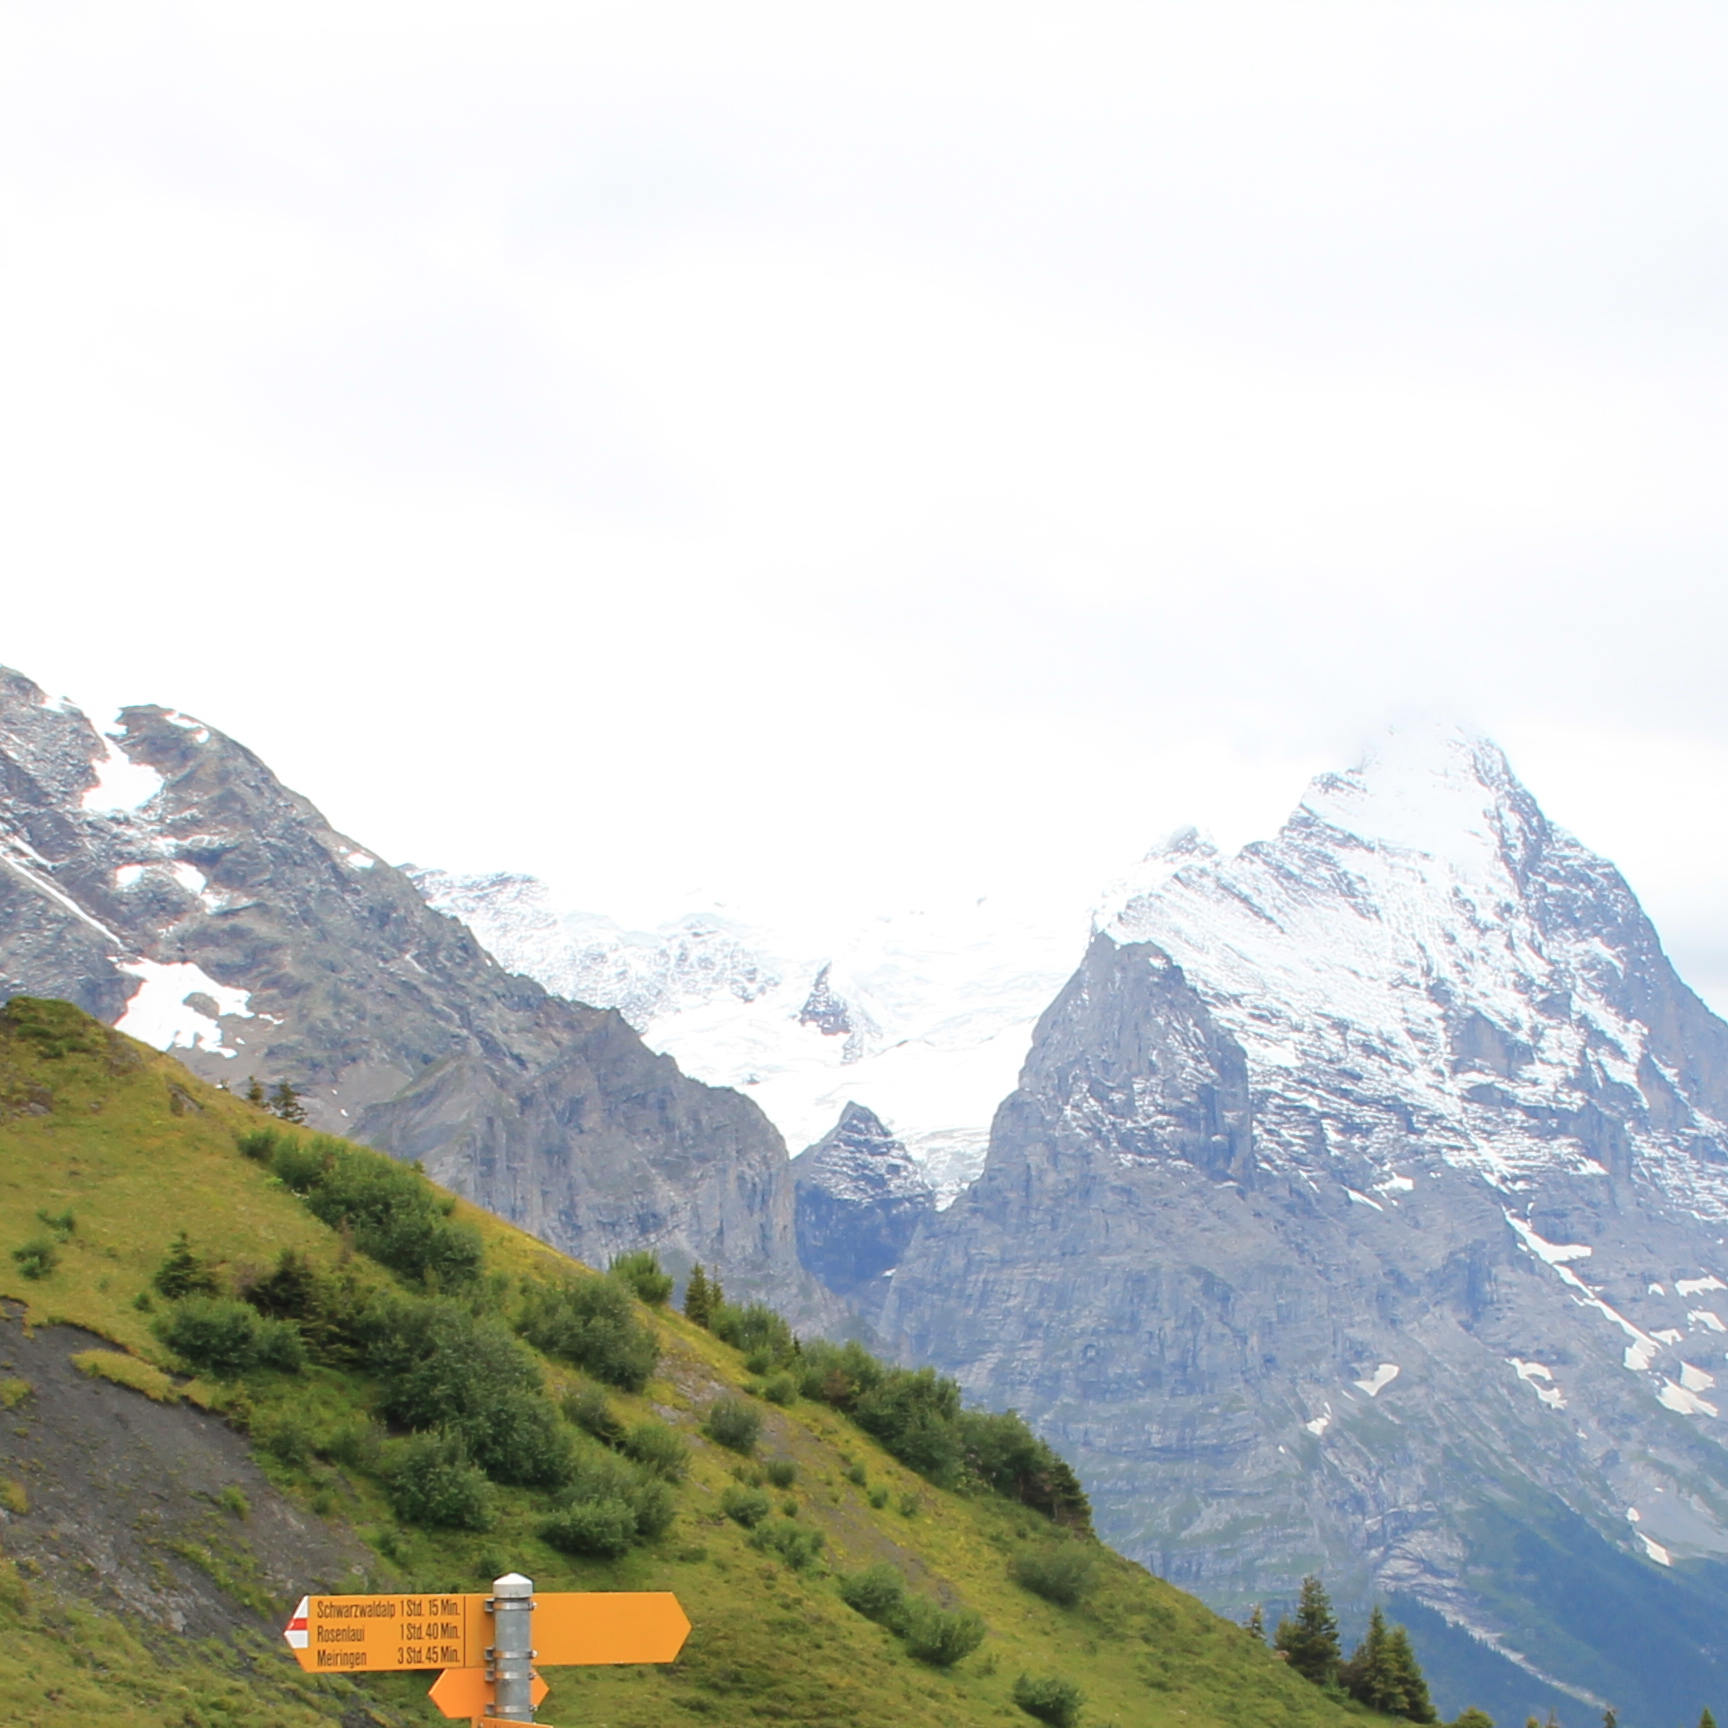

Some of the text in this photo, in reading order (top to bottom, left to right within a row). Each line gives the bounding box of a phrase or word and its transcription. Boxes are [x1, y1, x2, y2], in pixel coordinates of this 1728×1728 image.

[317, 1600, 395, 1619] Schwarzwaldalp
[406, 1599, 424, 1616] Std.
[428, 1600, 439, 1616] 15
[440, 1599, 460, 1616] Min.
[317, 1625, 365, 1642] Rosenlaui
[406, 1623, 424, 1640] Std.
[425, 1623, 439, 1639] 40
[440, 1623, 460, 1639] Min.
[317, 1646, 460, 1668] Meiringen 3 Std. 45 Min.
